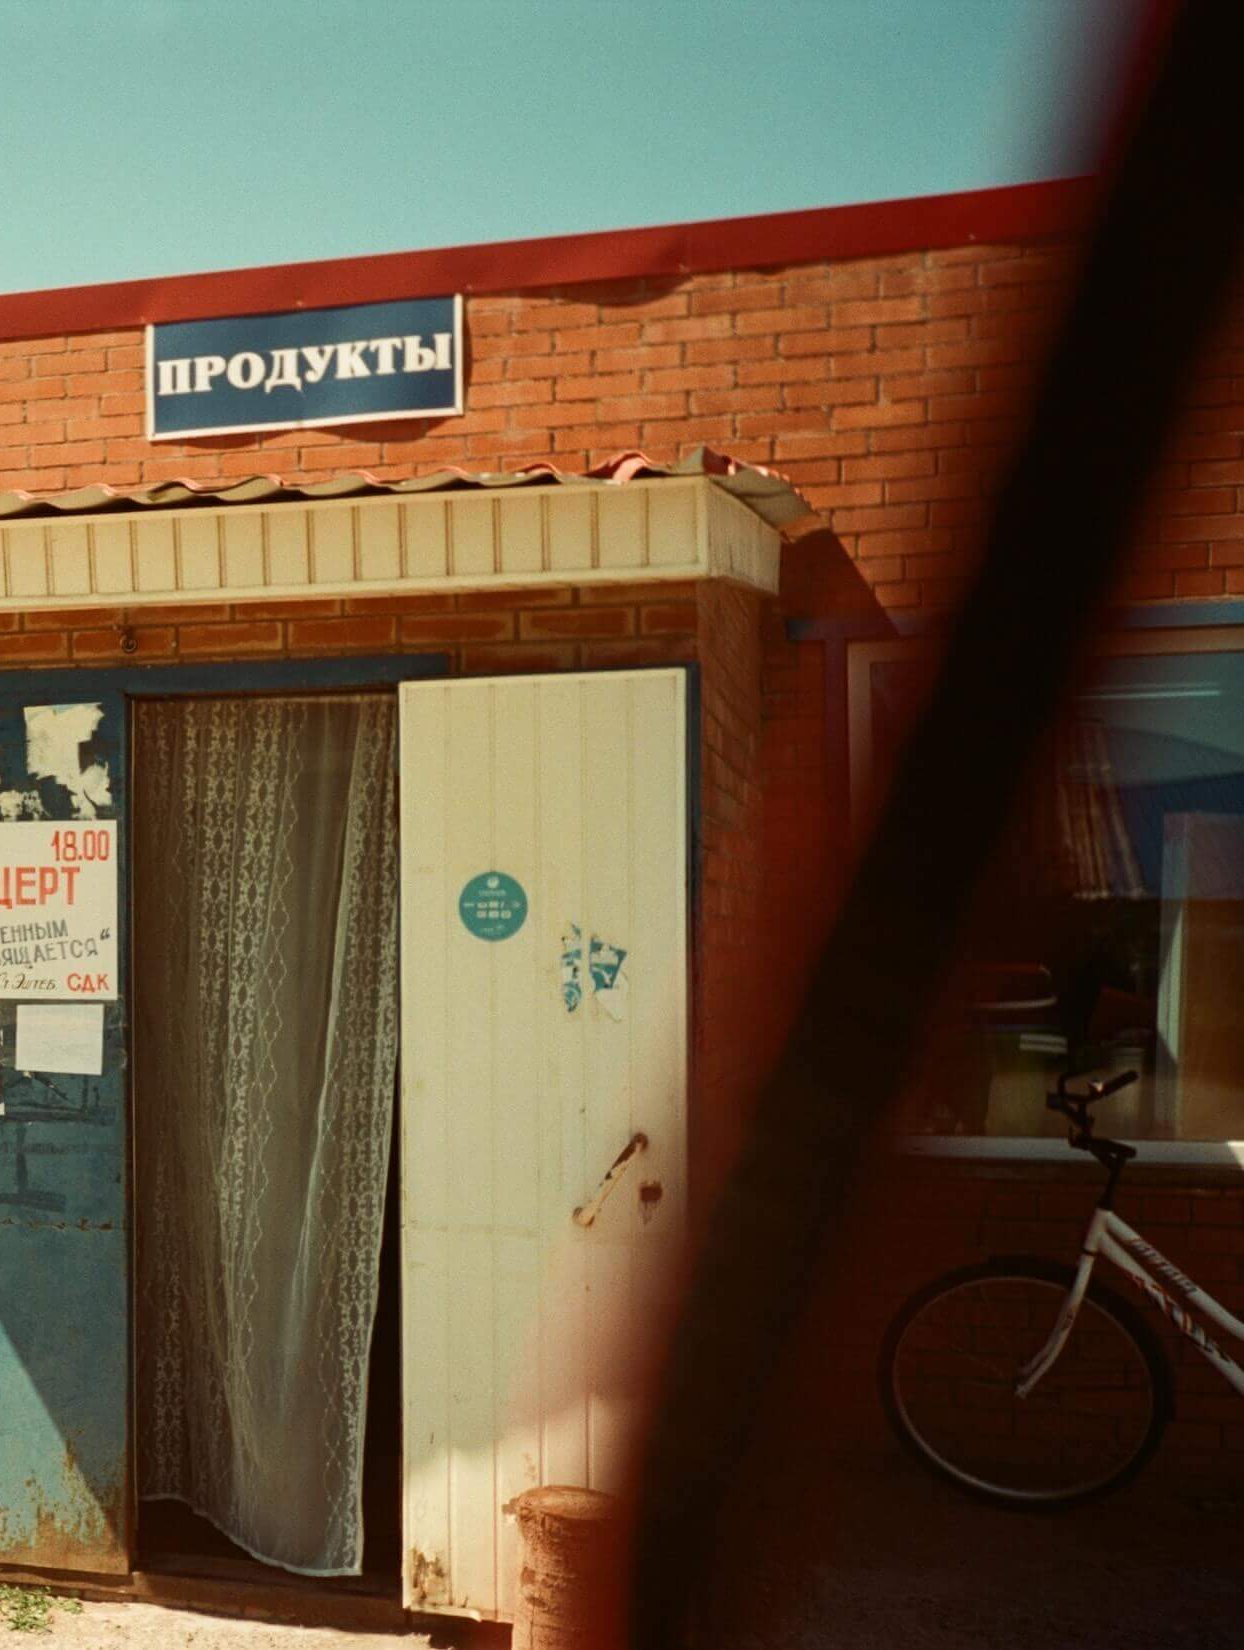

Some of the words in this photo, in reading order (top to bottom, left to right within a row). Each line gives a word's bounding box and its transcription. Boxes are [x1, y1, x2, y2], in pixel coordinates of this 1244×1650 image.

[157, 333, 452, 395] ПРОДУКТЫ
[51, 830, 110, 862] 18.00
[67, 973, 110, 993] СДК
